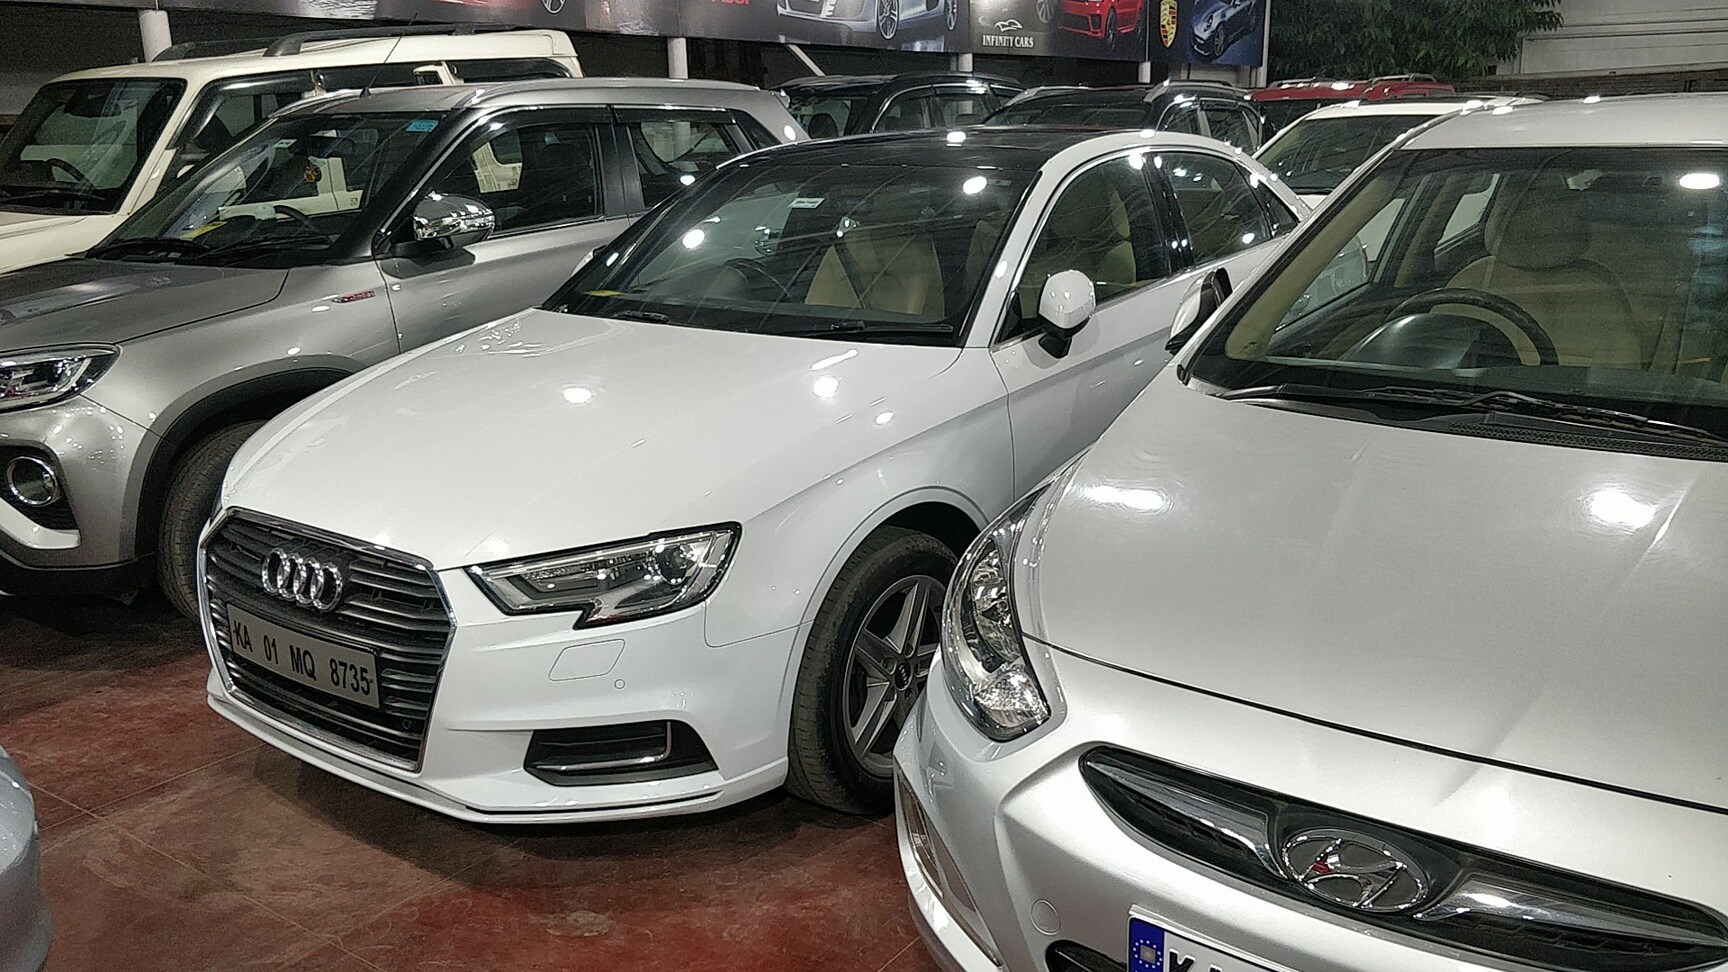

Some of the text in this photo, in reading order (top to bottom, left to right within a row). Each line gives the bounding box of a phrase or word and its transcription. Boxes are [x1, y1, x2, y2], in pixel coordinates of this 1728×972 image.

[982, 34, 1034, 48] INFINITY CARS
[233, 620, 371, 696] KA 01 MQ 8735
